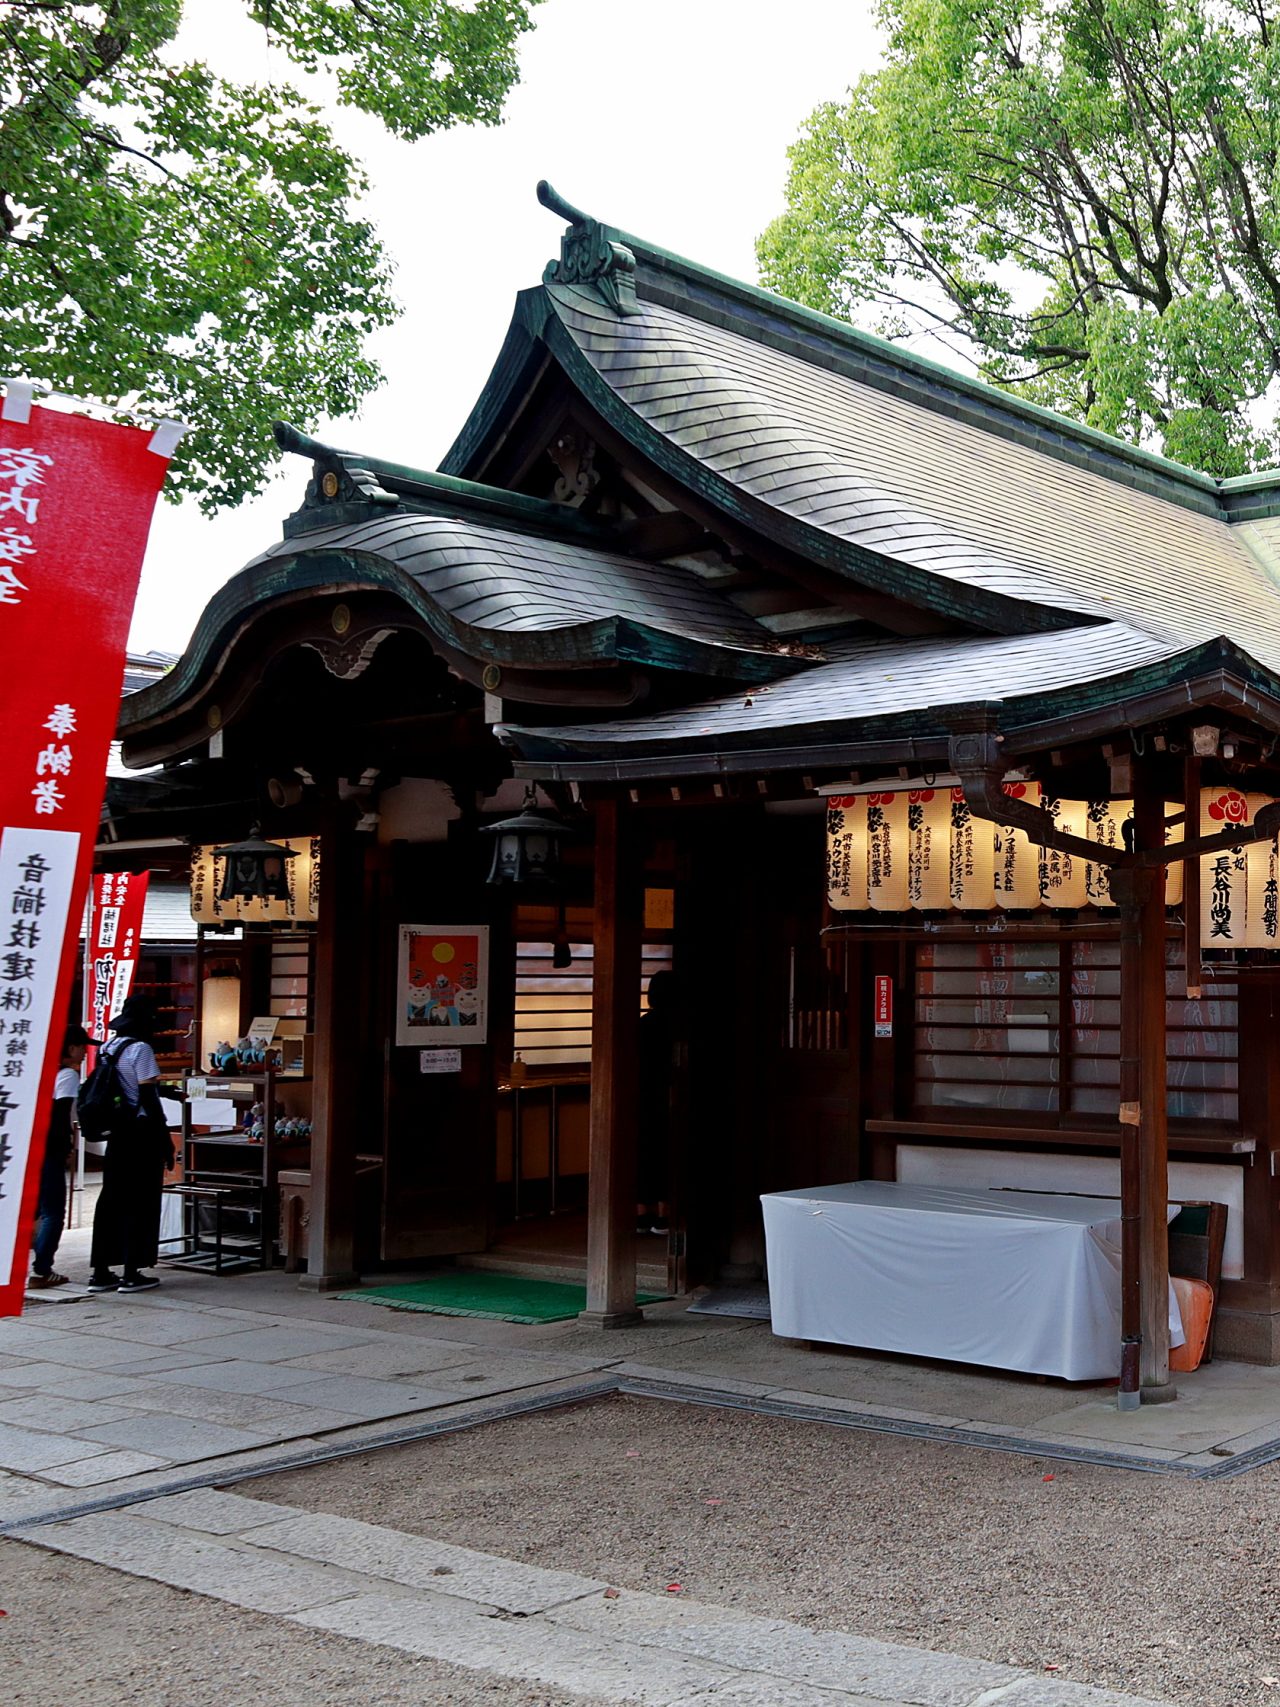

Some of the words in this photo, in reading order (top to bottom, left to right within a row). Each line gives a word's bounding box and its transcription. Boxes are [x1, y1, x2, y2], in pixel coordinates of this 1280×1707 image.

[1210, 855, 1234, 940] 長谷川尚美
